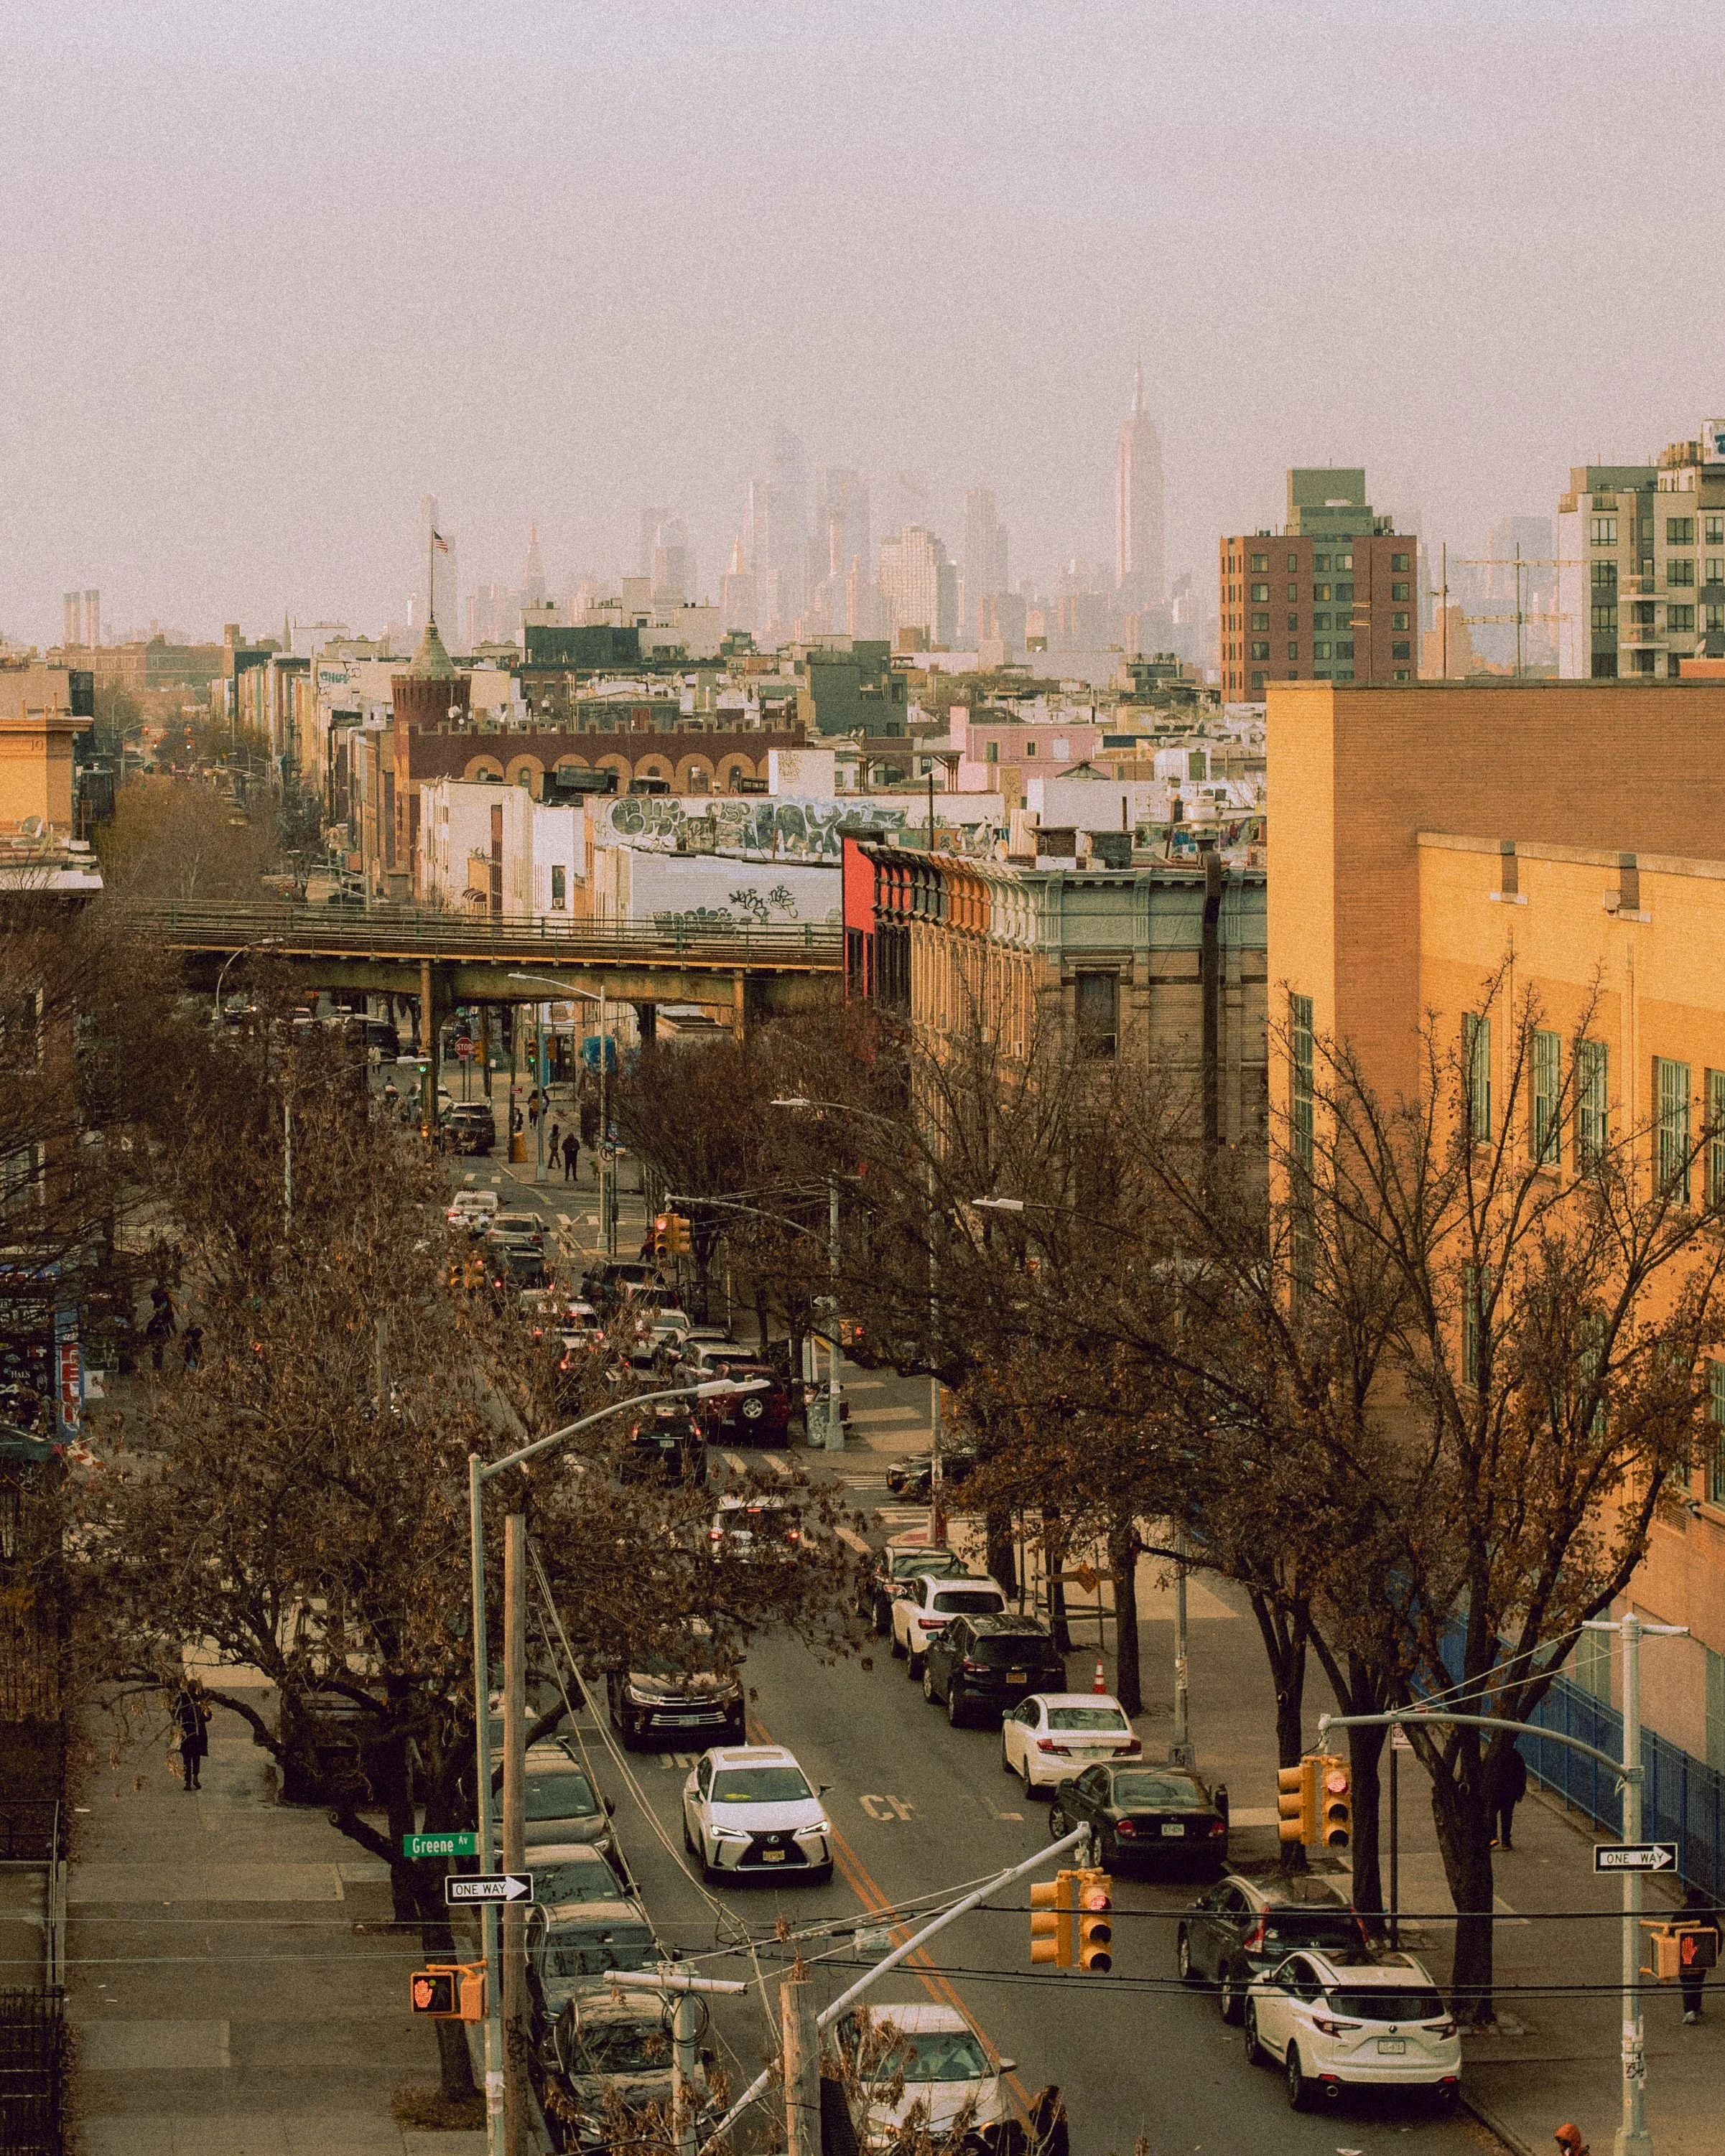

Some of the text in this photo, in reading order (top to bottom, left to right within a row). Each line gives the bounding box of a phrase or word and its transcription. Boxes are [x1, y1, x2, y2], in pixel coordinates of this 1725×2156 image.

[412, 1835, 468, 1854] Greene Av
[1607, 1853, 1664, 1864] ONE WAY
[455, 1883, 506, 1895] ONE WAY
